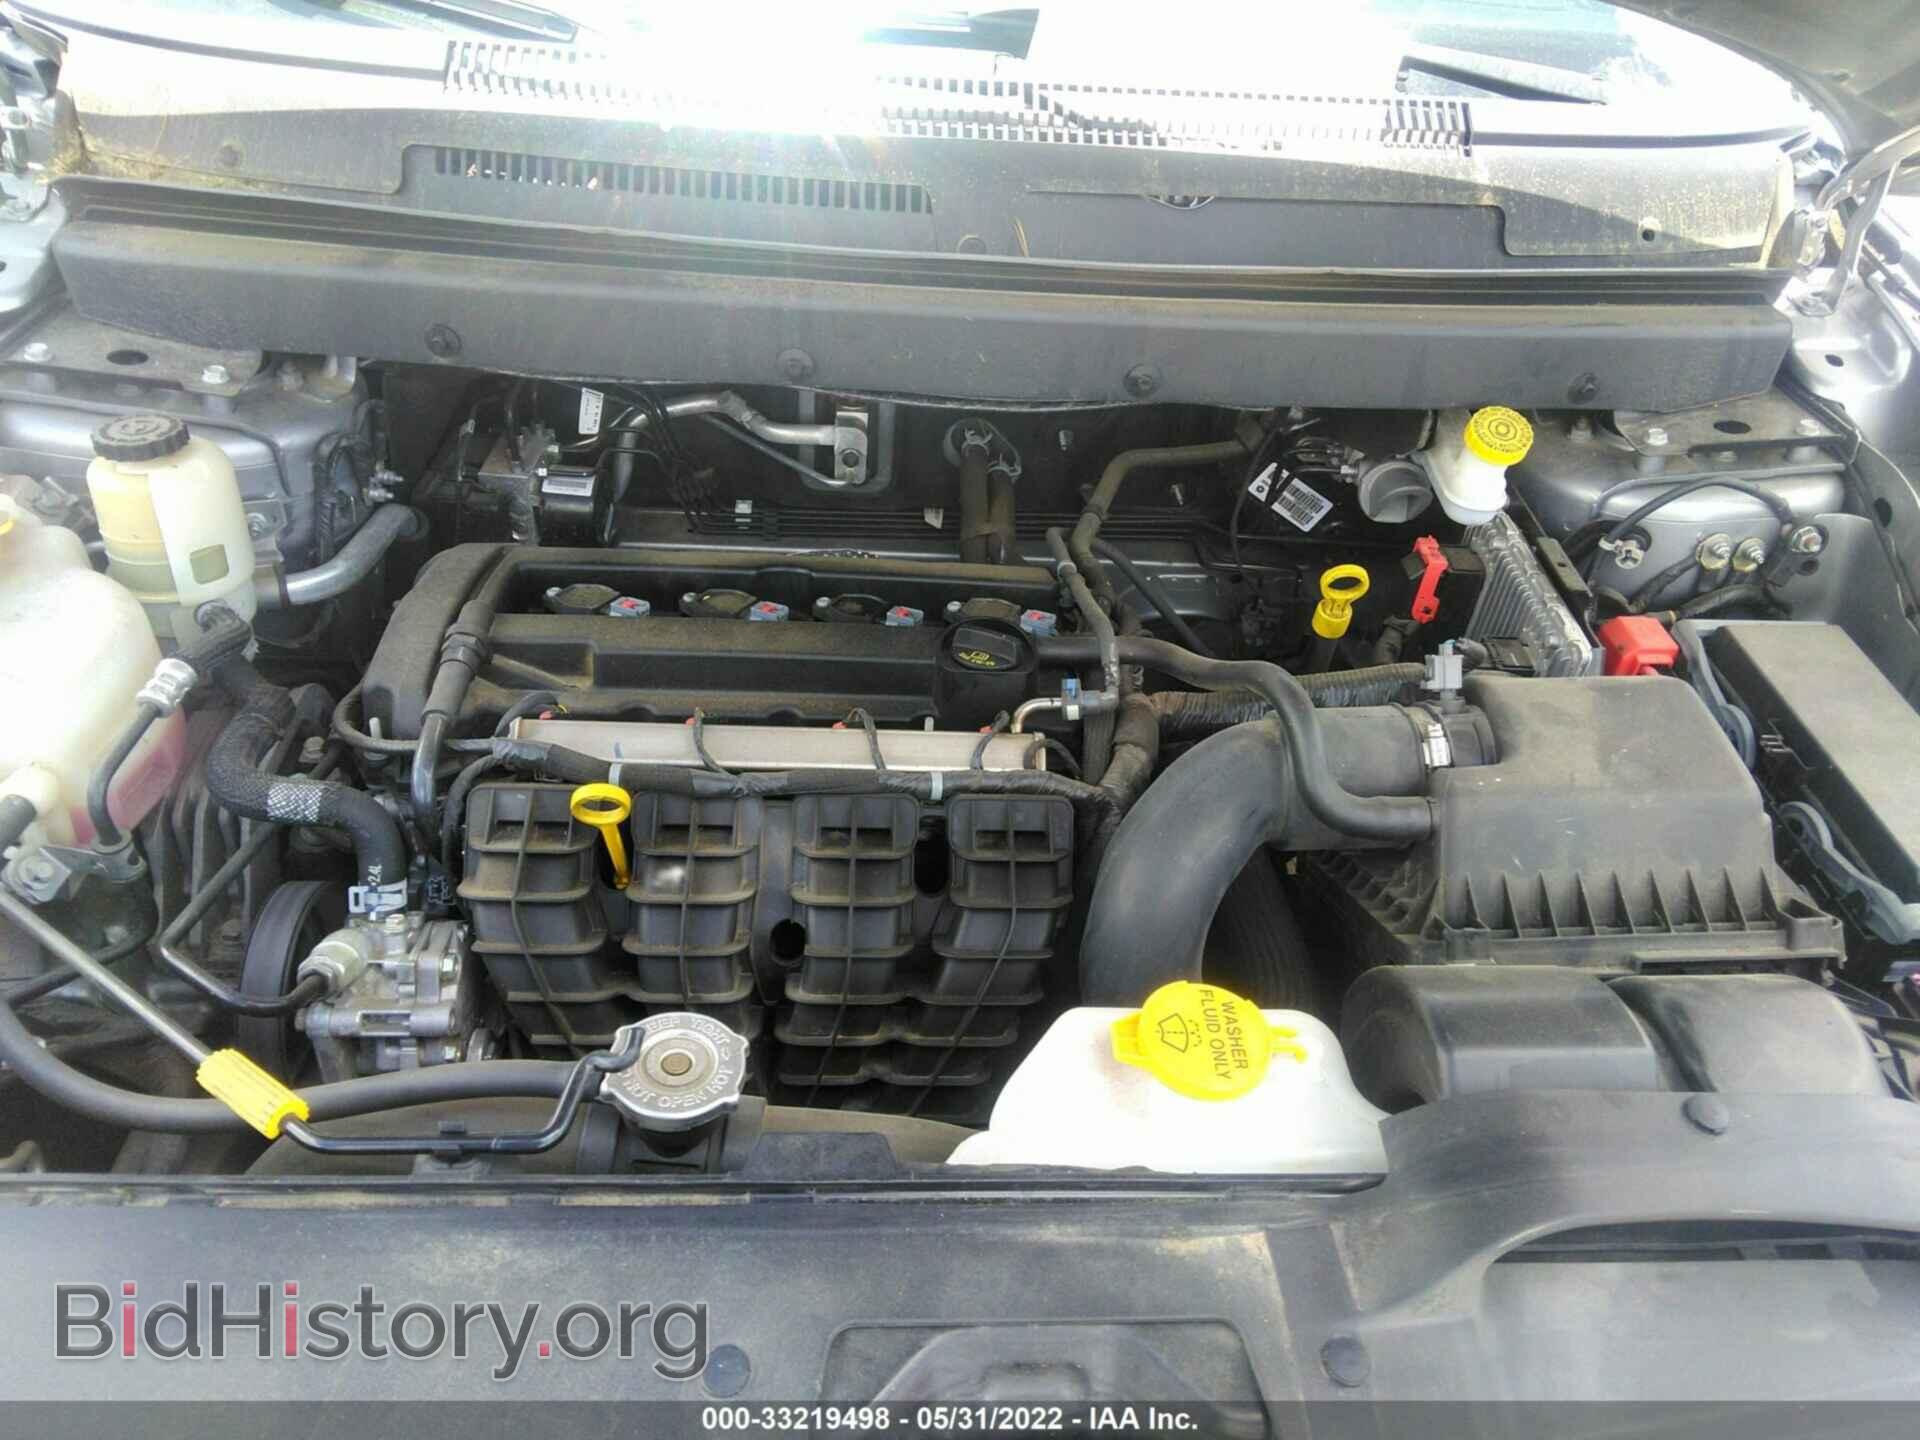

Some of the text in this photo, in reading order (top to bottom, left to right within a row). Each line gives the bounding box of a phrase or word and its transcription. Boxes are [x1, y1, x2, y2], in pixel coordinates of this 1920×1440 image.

[1200, 989, 1232, 1080] FLUID ONLY
[1221, 1001, 1249, 1069] WASHER
[657, 1089, 707, 1108] OPEN
